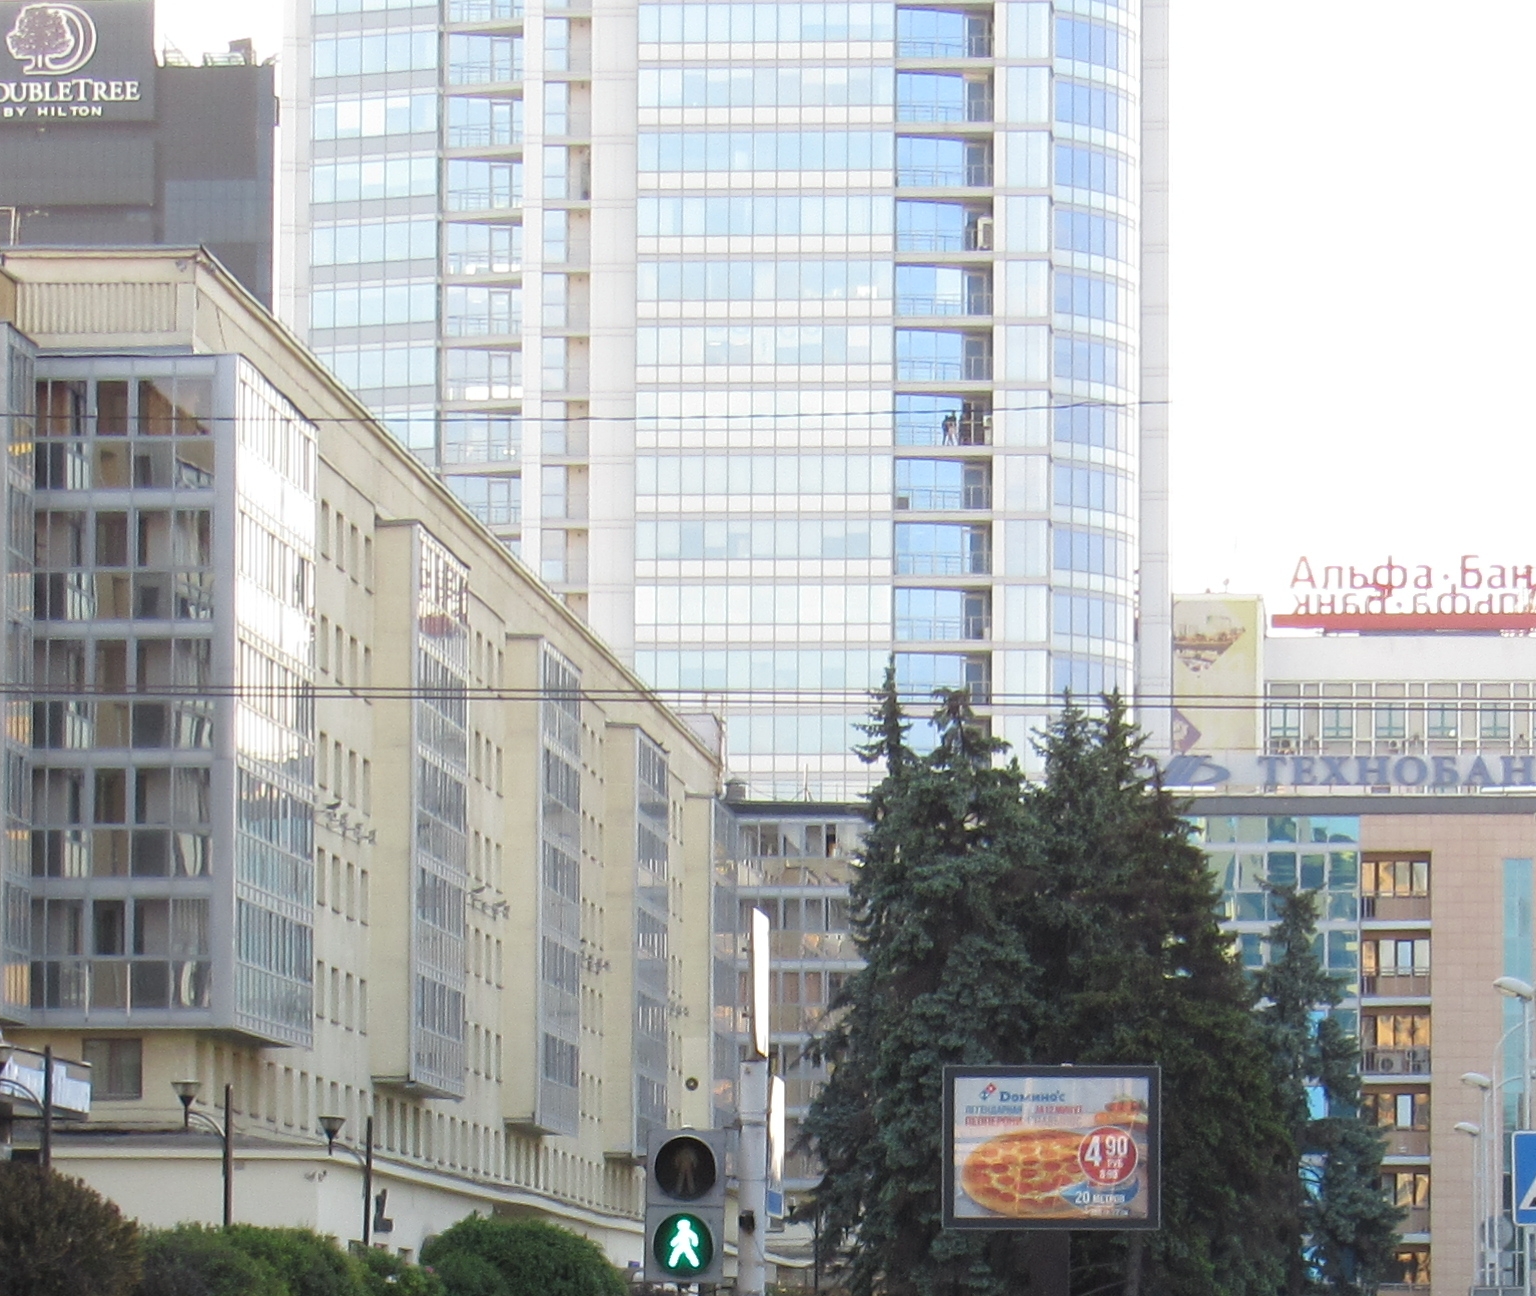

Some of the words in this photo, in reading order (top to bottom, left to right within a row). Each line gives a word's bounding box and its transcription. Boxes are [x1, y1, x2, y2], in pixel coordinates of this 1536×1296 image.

[3, 106, 28, 118] BY
[37, 105, 103, 117] HILTON
[1084, 1135, 1102, 1167] 4
[1106, 1135, 1129, 1156] 90
[1075, 1190, 1091, 1204] 20
